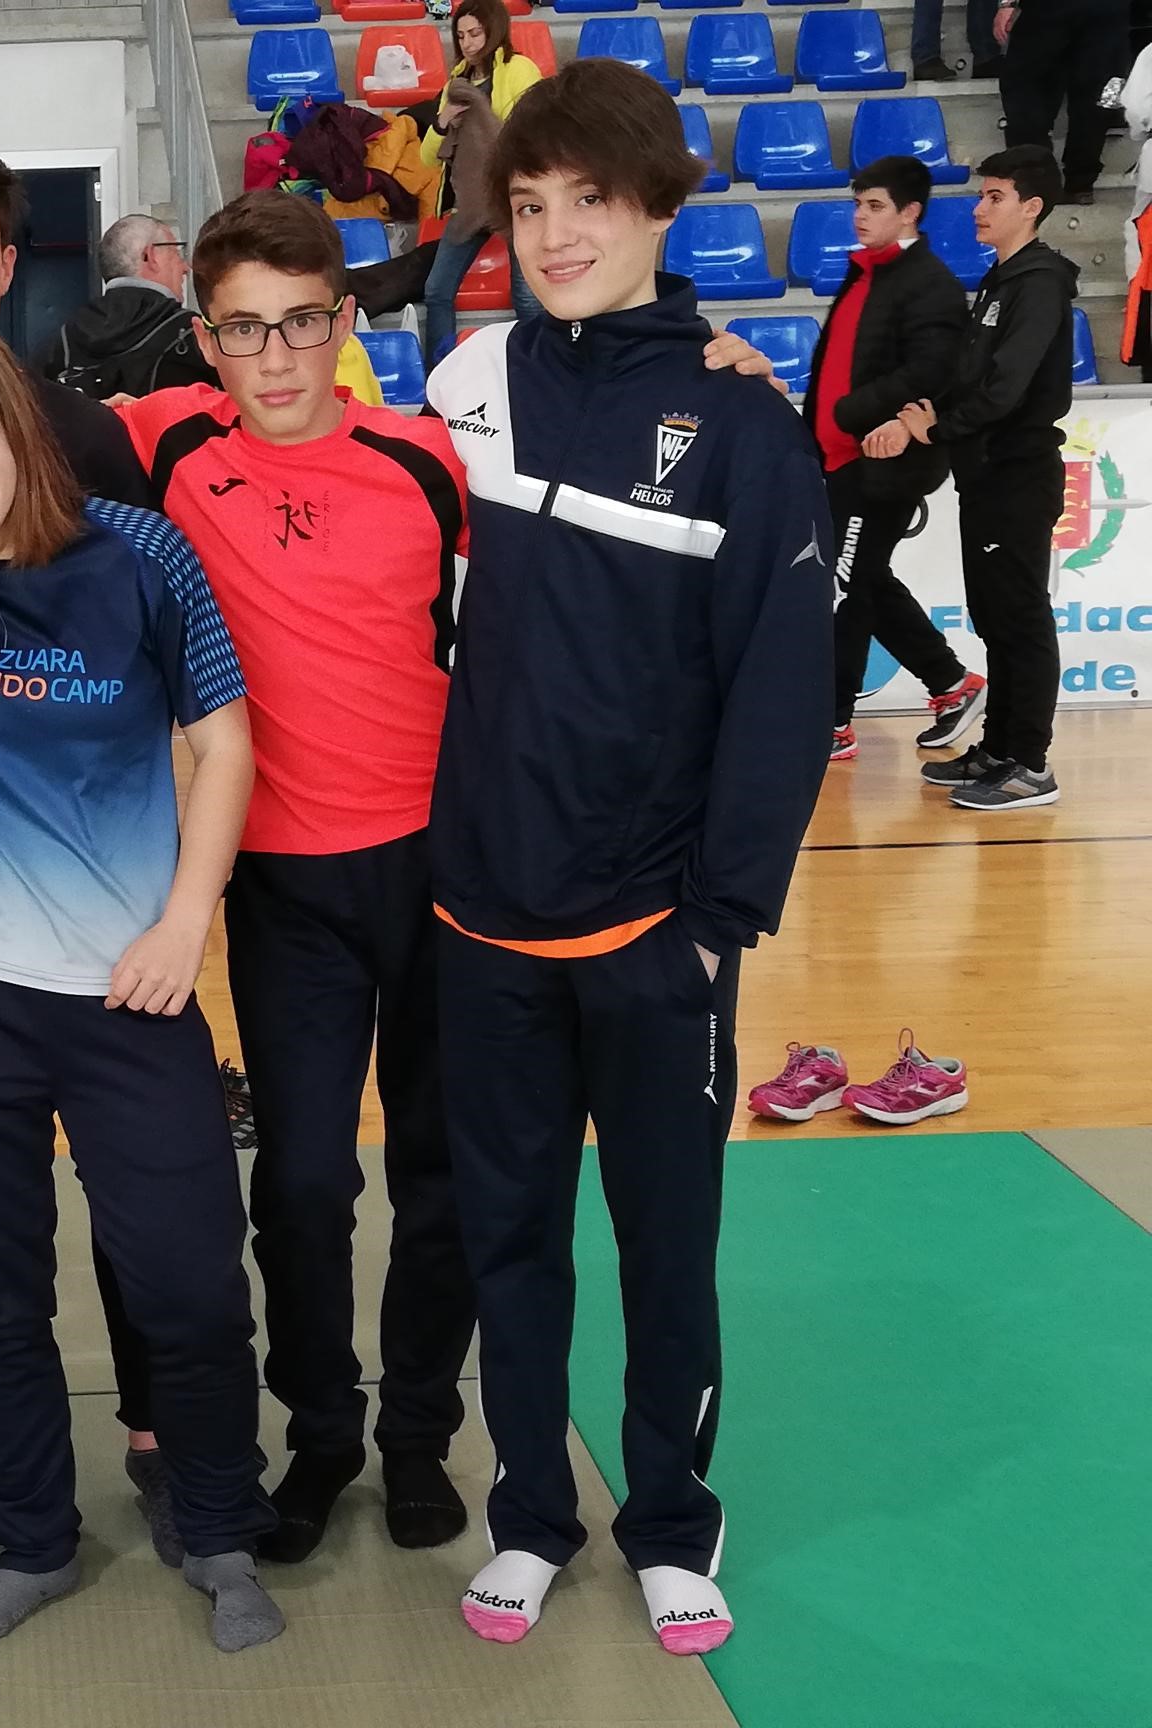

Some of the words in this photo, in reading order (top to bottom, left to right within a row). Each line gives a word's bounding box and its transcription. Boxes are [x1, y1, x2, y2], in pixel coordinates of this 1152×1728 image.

[630, 488, 674, 506] HELIOS
[1061, 660, 1136, 692] de
[709, 1012, 718, 1073] MERCURY
[656, 1608, 719, 1627] mistral
